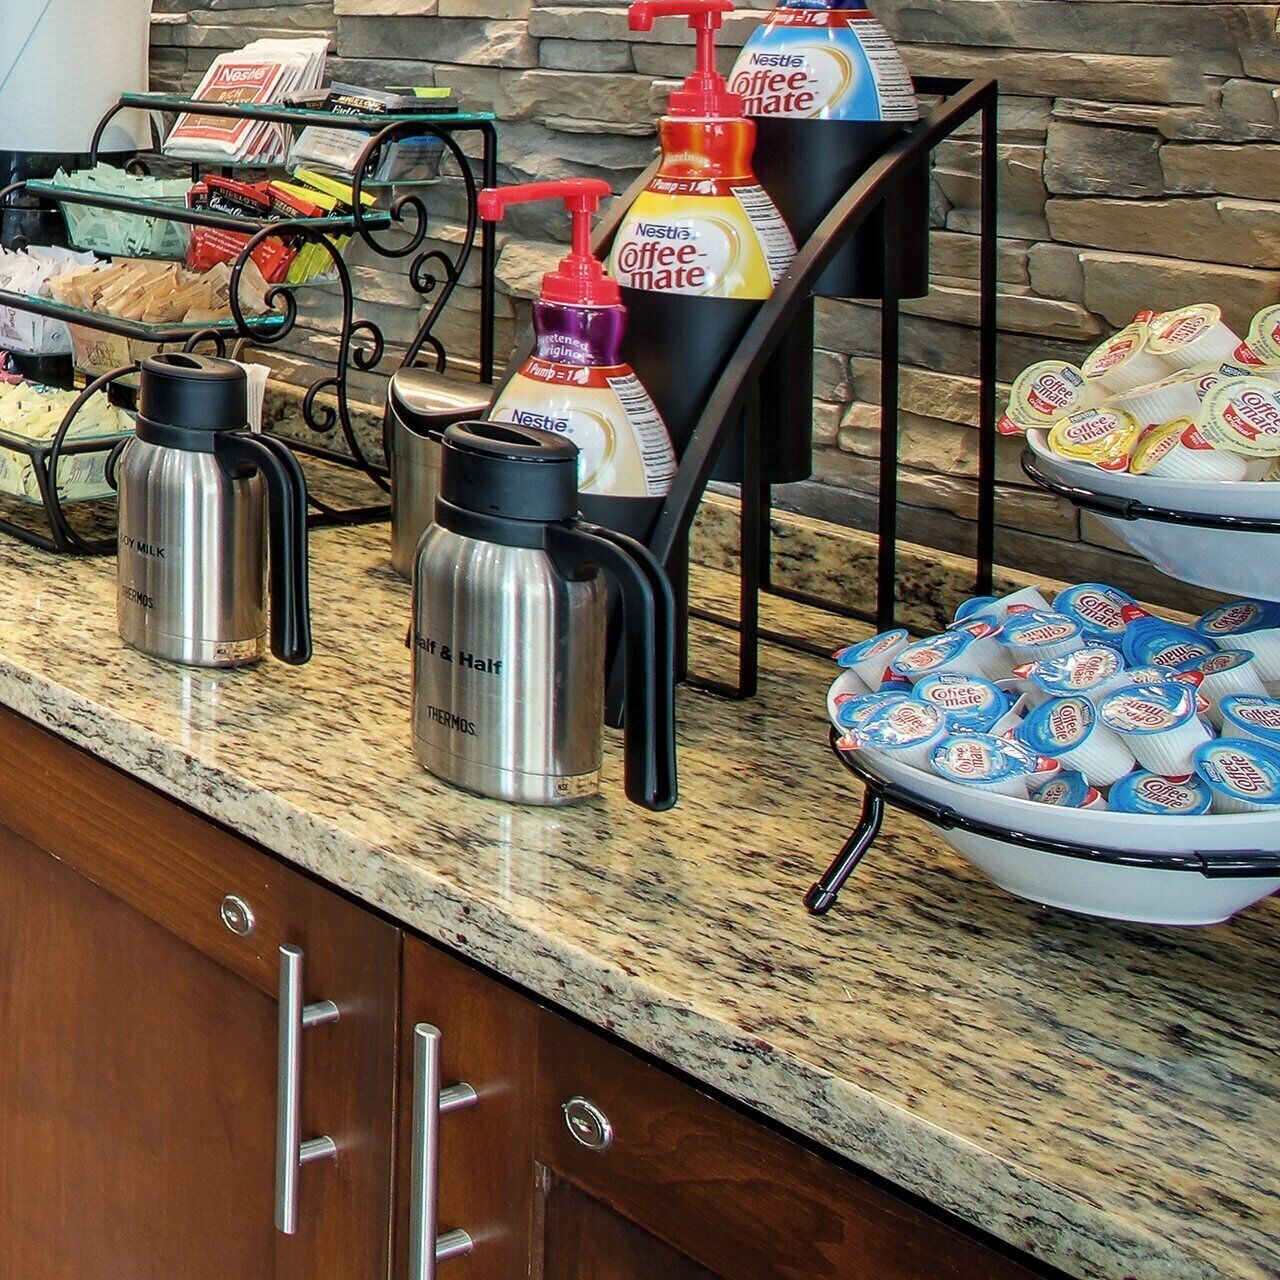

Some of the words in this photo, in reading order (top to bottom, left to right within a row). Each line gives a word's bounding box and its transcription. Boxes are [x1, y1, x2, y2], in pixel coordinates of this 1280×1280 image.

[217, 88, 244, 102] RICH
[338, 95, 382, 111] BIGELOW
[741, 91, 815, 115] mate
[653, 179, 679, 194] Pump
[630, 266, 706, 291] mate
[530, 363, 556, 381] Pump
[1038, 387, 1068, 408] mate
[1081, 421, 1116, 441] mate
[1239, 406, 1278, 436] mate
[137, 541, 165, 559] MILK
[122, 585, 154, 610] THERMOS
[1082, 606, 1119, 628] mate
[440, 645, 453, 663] &
[458, 650, 503, 675] Half
[944, 694, 982, 707] mate
[428, 705, 477, 737] THERMOS
